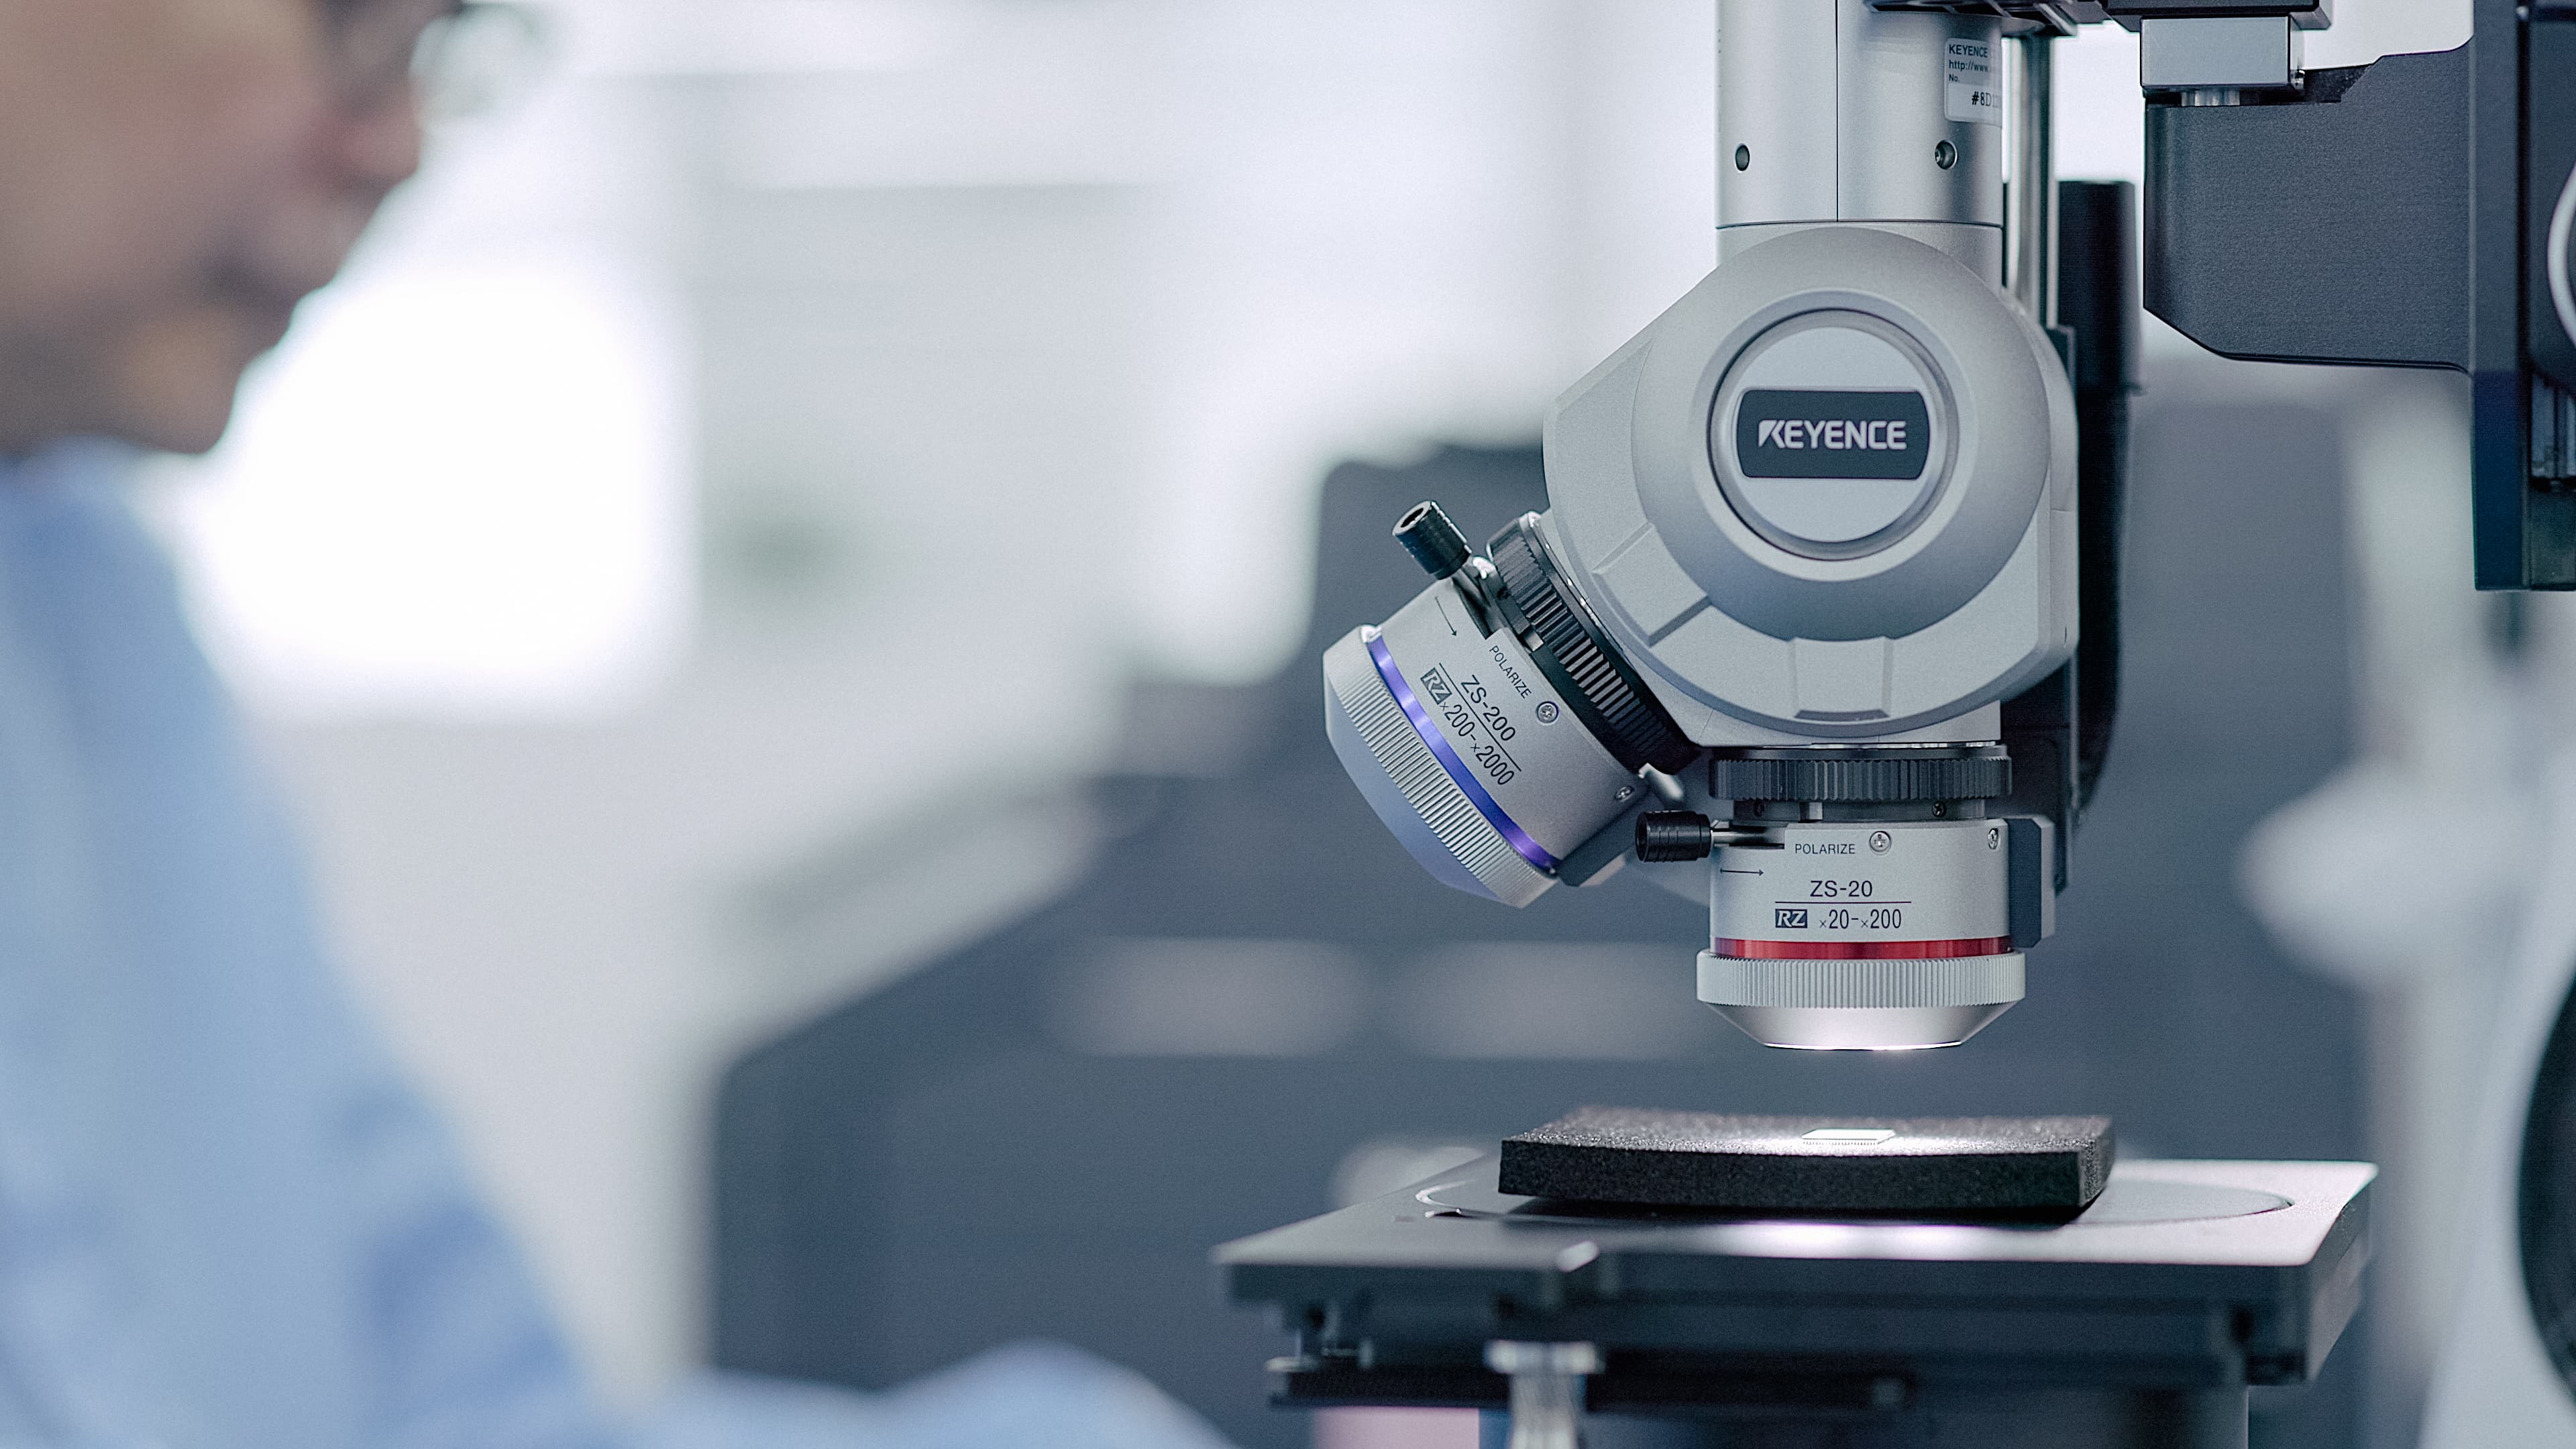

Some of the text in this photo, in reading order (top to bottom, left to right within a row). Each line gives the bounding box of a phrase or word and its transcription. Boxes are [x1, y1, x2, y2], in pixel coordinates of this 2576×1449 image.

[1949, 44, 1988, 58] KEYENCE
[1758, 419, 1907, 449] KEYENCE
[1489, 645, 1532, 699] POLARIZE
[1421, 669, 1452, 704] RZ
[1460, 674, 1516, 741] ZS-200
[1794, 843, 1856, 855] POLARIZE
[1810, 880, 1873, 898] ZS-20
[1776, 910, 1807, 928] RZ
